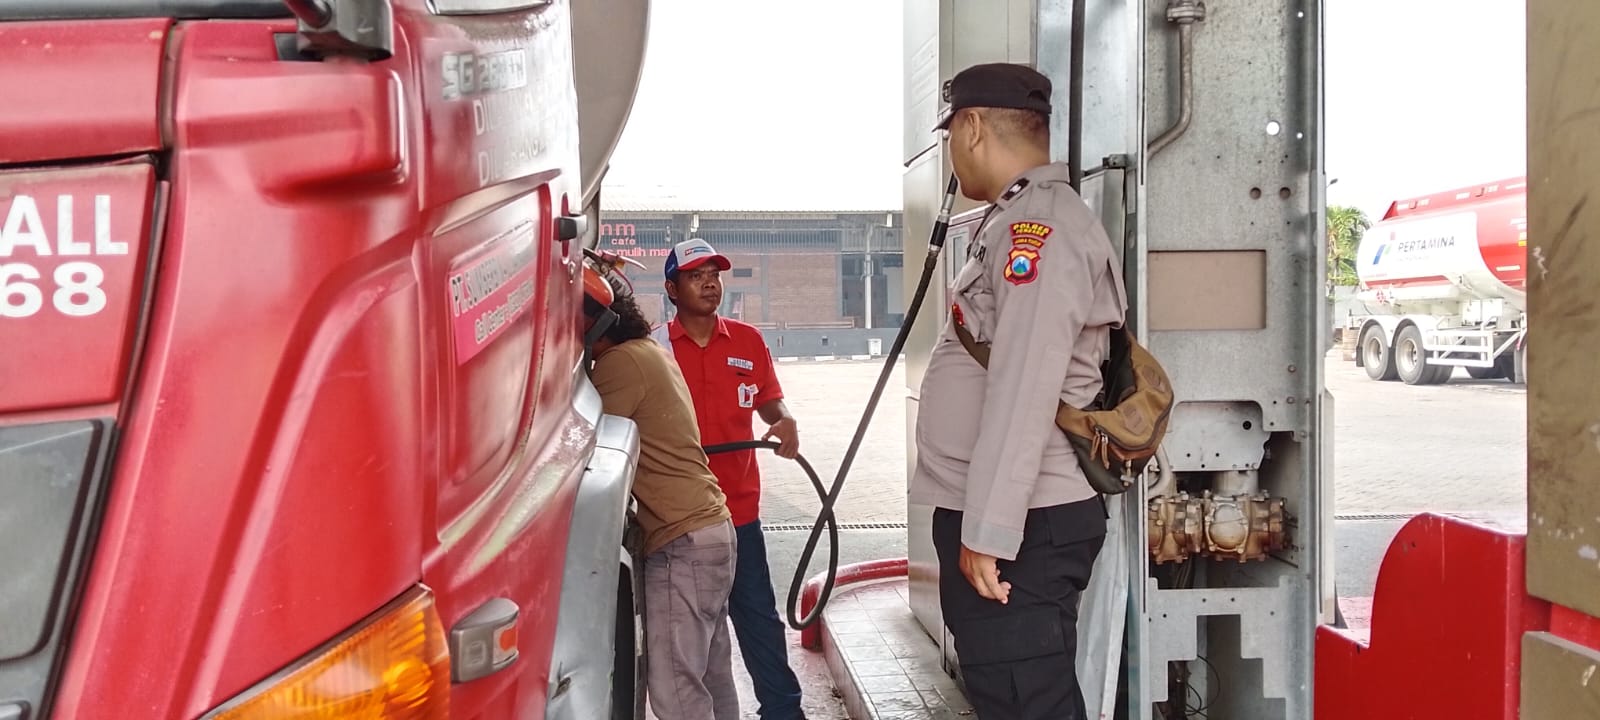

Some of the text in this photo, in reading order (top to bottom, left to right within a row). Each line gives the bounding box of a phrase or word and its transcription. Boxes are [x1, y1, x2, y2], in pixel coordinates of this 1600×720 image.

[0, 194, 129, 257] ALL
[611, 238, 636, 246] cafe
[1398, 236, 1455, 253] PERTAMINA
